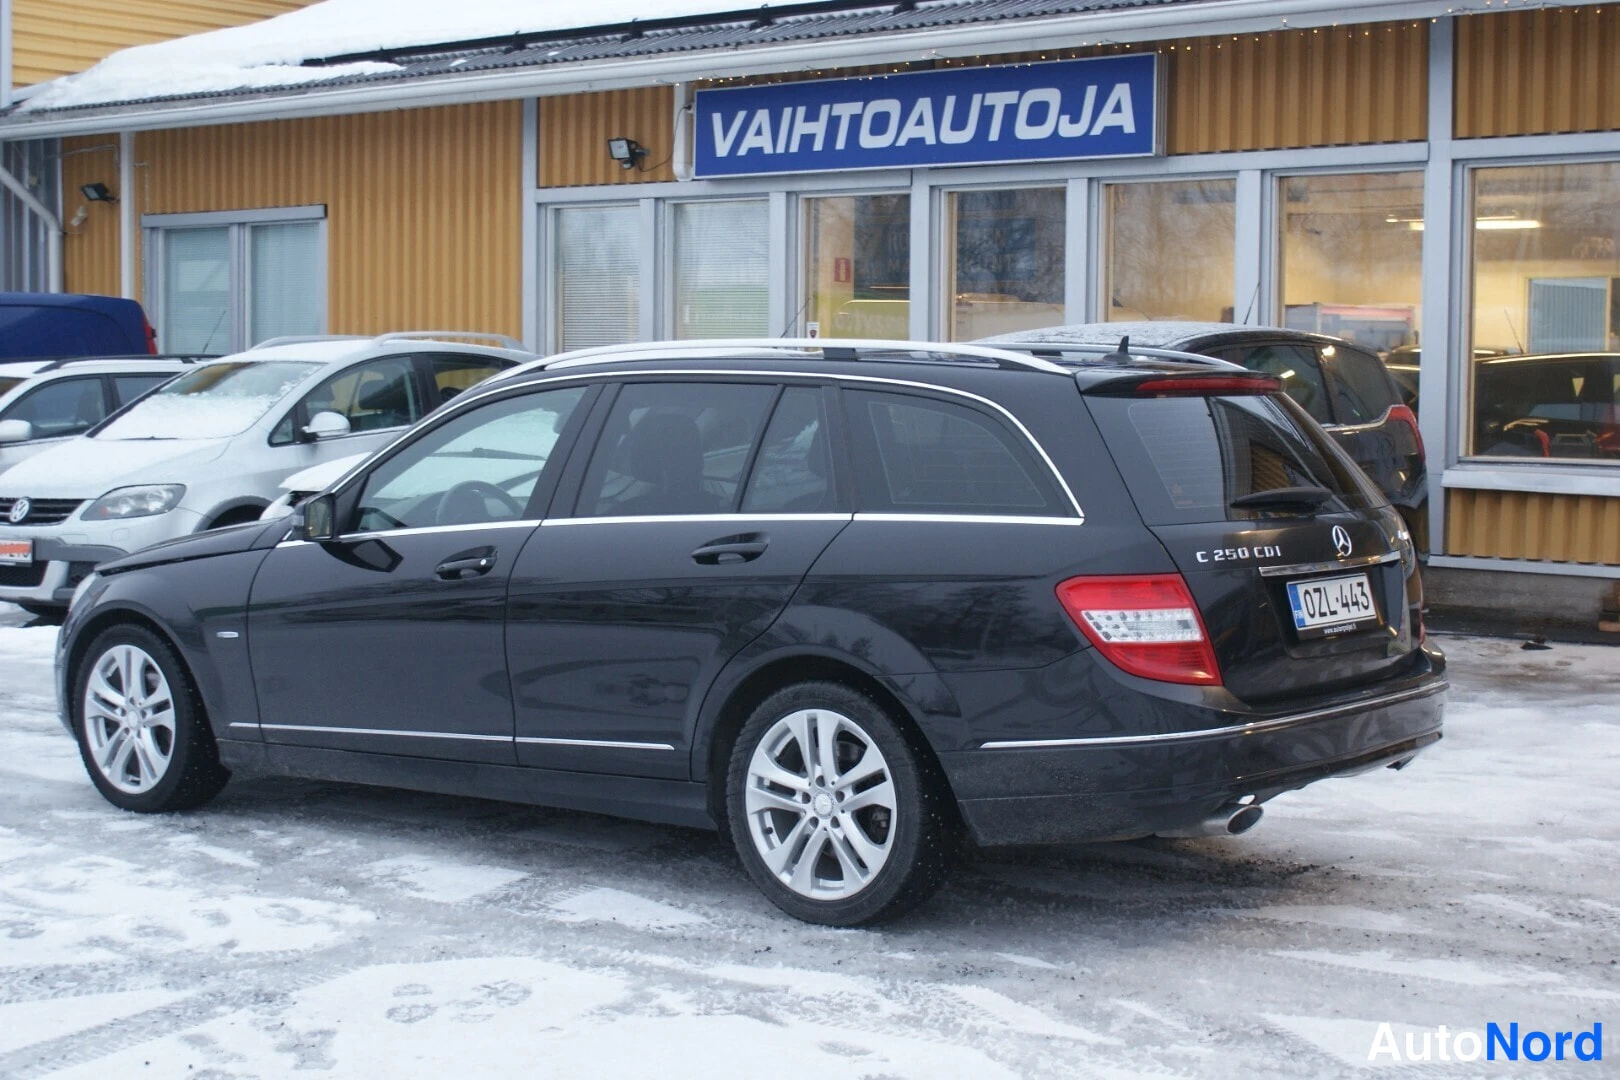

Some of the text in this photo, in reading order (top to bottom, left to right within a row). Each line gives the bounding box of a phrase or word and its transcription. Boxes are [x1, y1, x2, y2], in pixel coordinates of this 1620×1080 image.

[711, 82, 1136, 158] VAIHTOAUTOJA
[1196, 545, 1282, 563] C 250 CDI
[1303, 581, 1370, 619] OZL-443
